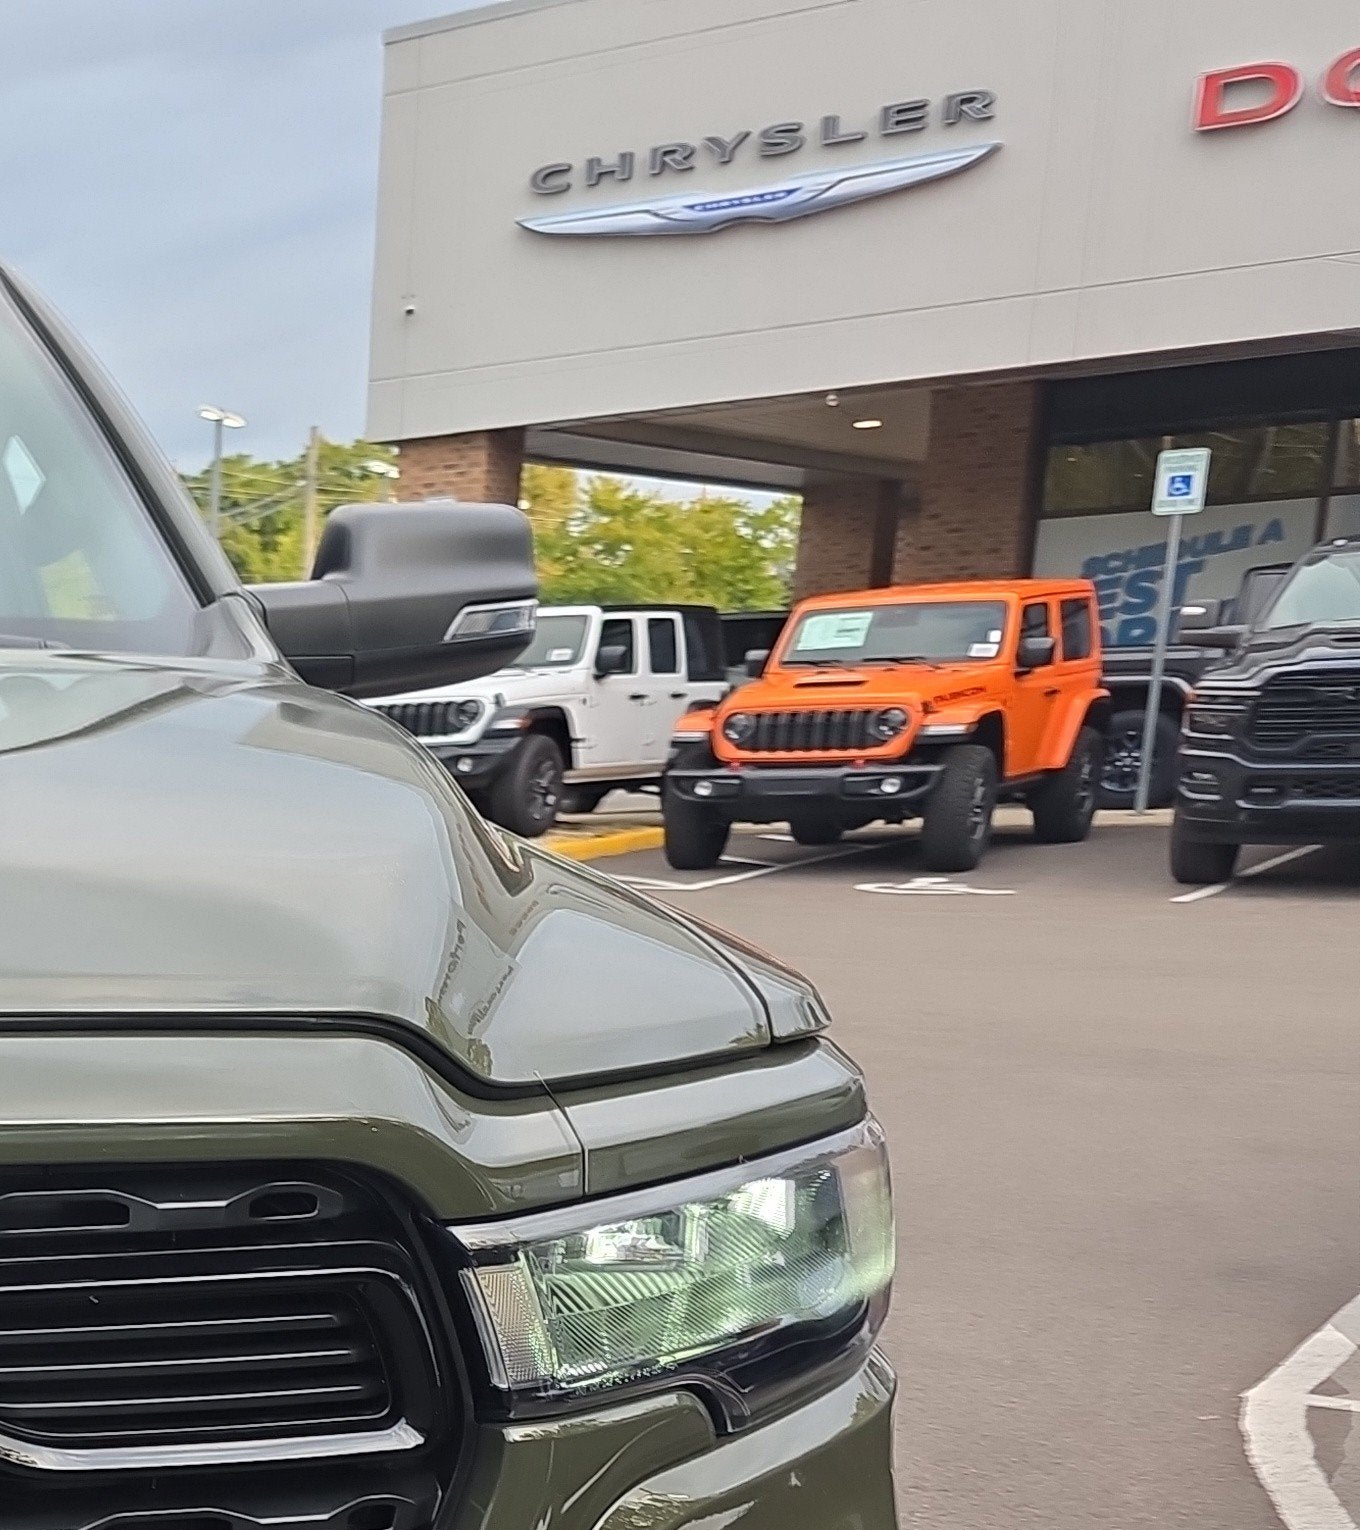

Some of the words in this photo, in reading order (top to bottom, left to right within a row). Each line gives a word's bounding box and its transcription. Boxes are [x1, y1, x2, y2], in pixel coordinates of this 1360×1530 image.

[530, 88, 998, 195] CHRYSLER
[1257, 517, 1285, 546] A
[1097, 558, 1206, 620] EST
